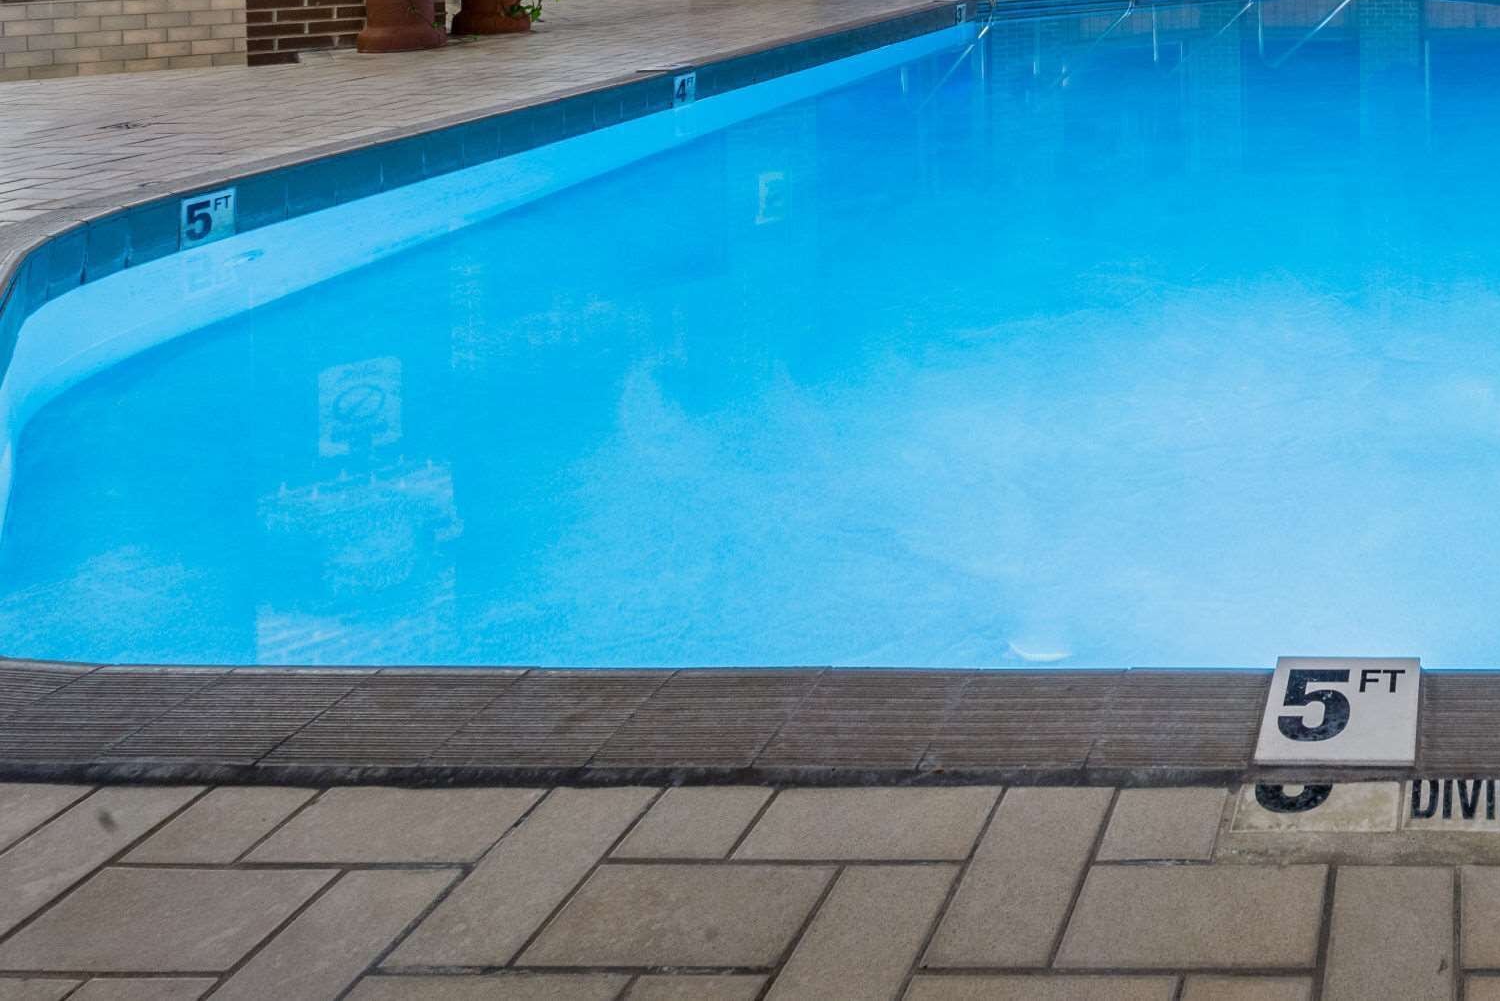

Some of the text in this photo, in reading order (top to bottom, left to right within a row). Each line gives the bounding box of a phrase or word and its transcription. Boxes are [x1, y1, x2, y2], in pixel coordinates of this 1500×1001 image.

[676, 78, 687, 103] 4
[185, 195, 233, 241] 5 FT
[1277, 669, 1406, 742] 5 FT
